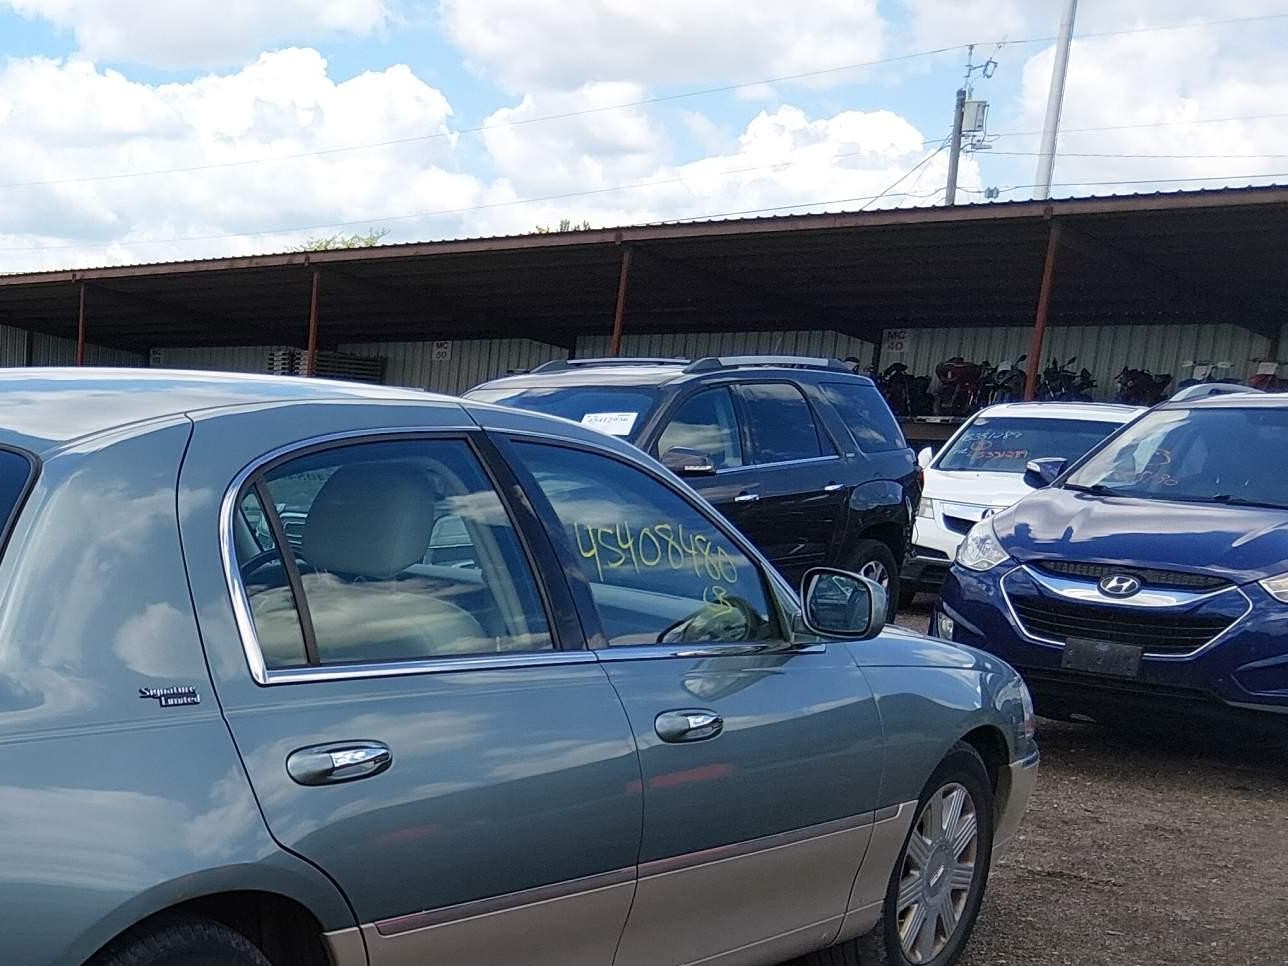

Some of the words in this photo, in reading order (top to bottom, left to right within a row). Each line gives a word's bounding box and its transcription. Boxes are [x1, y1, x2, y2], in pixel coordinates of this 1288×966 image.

[574, 521, 738, 583] 45408480
[138, 686, 196, 698] Signature
[160, 694, 200, 707] Limited
